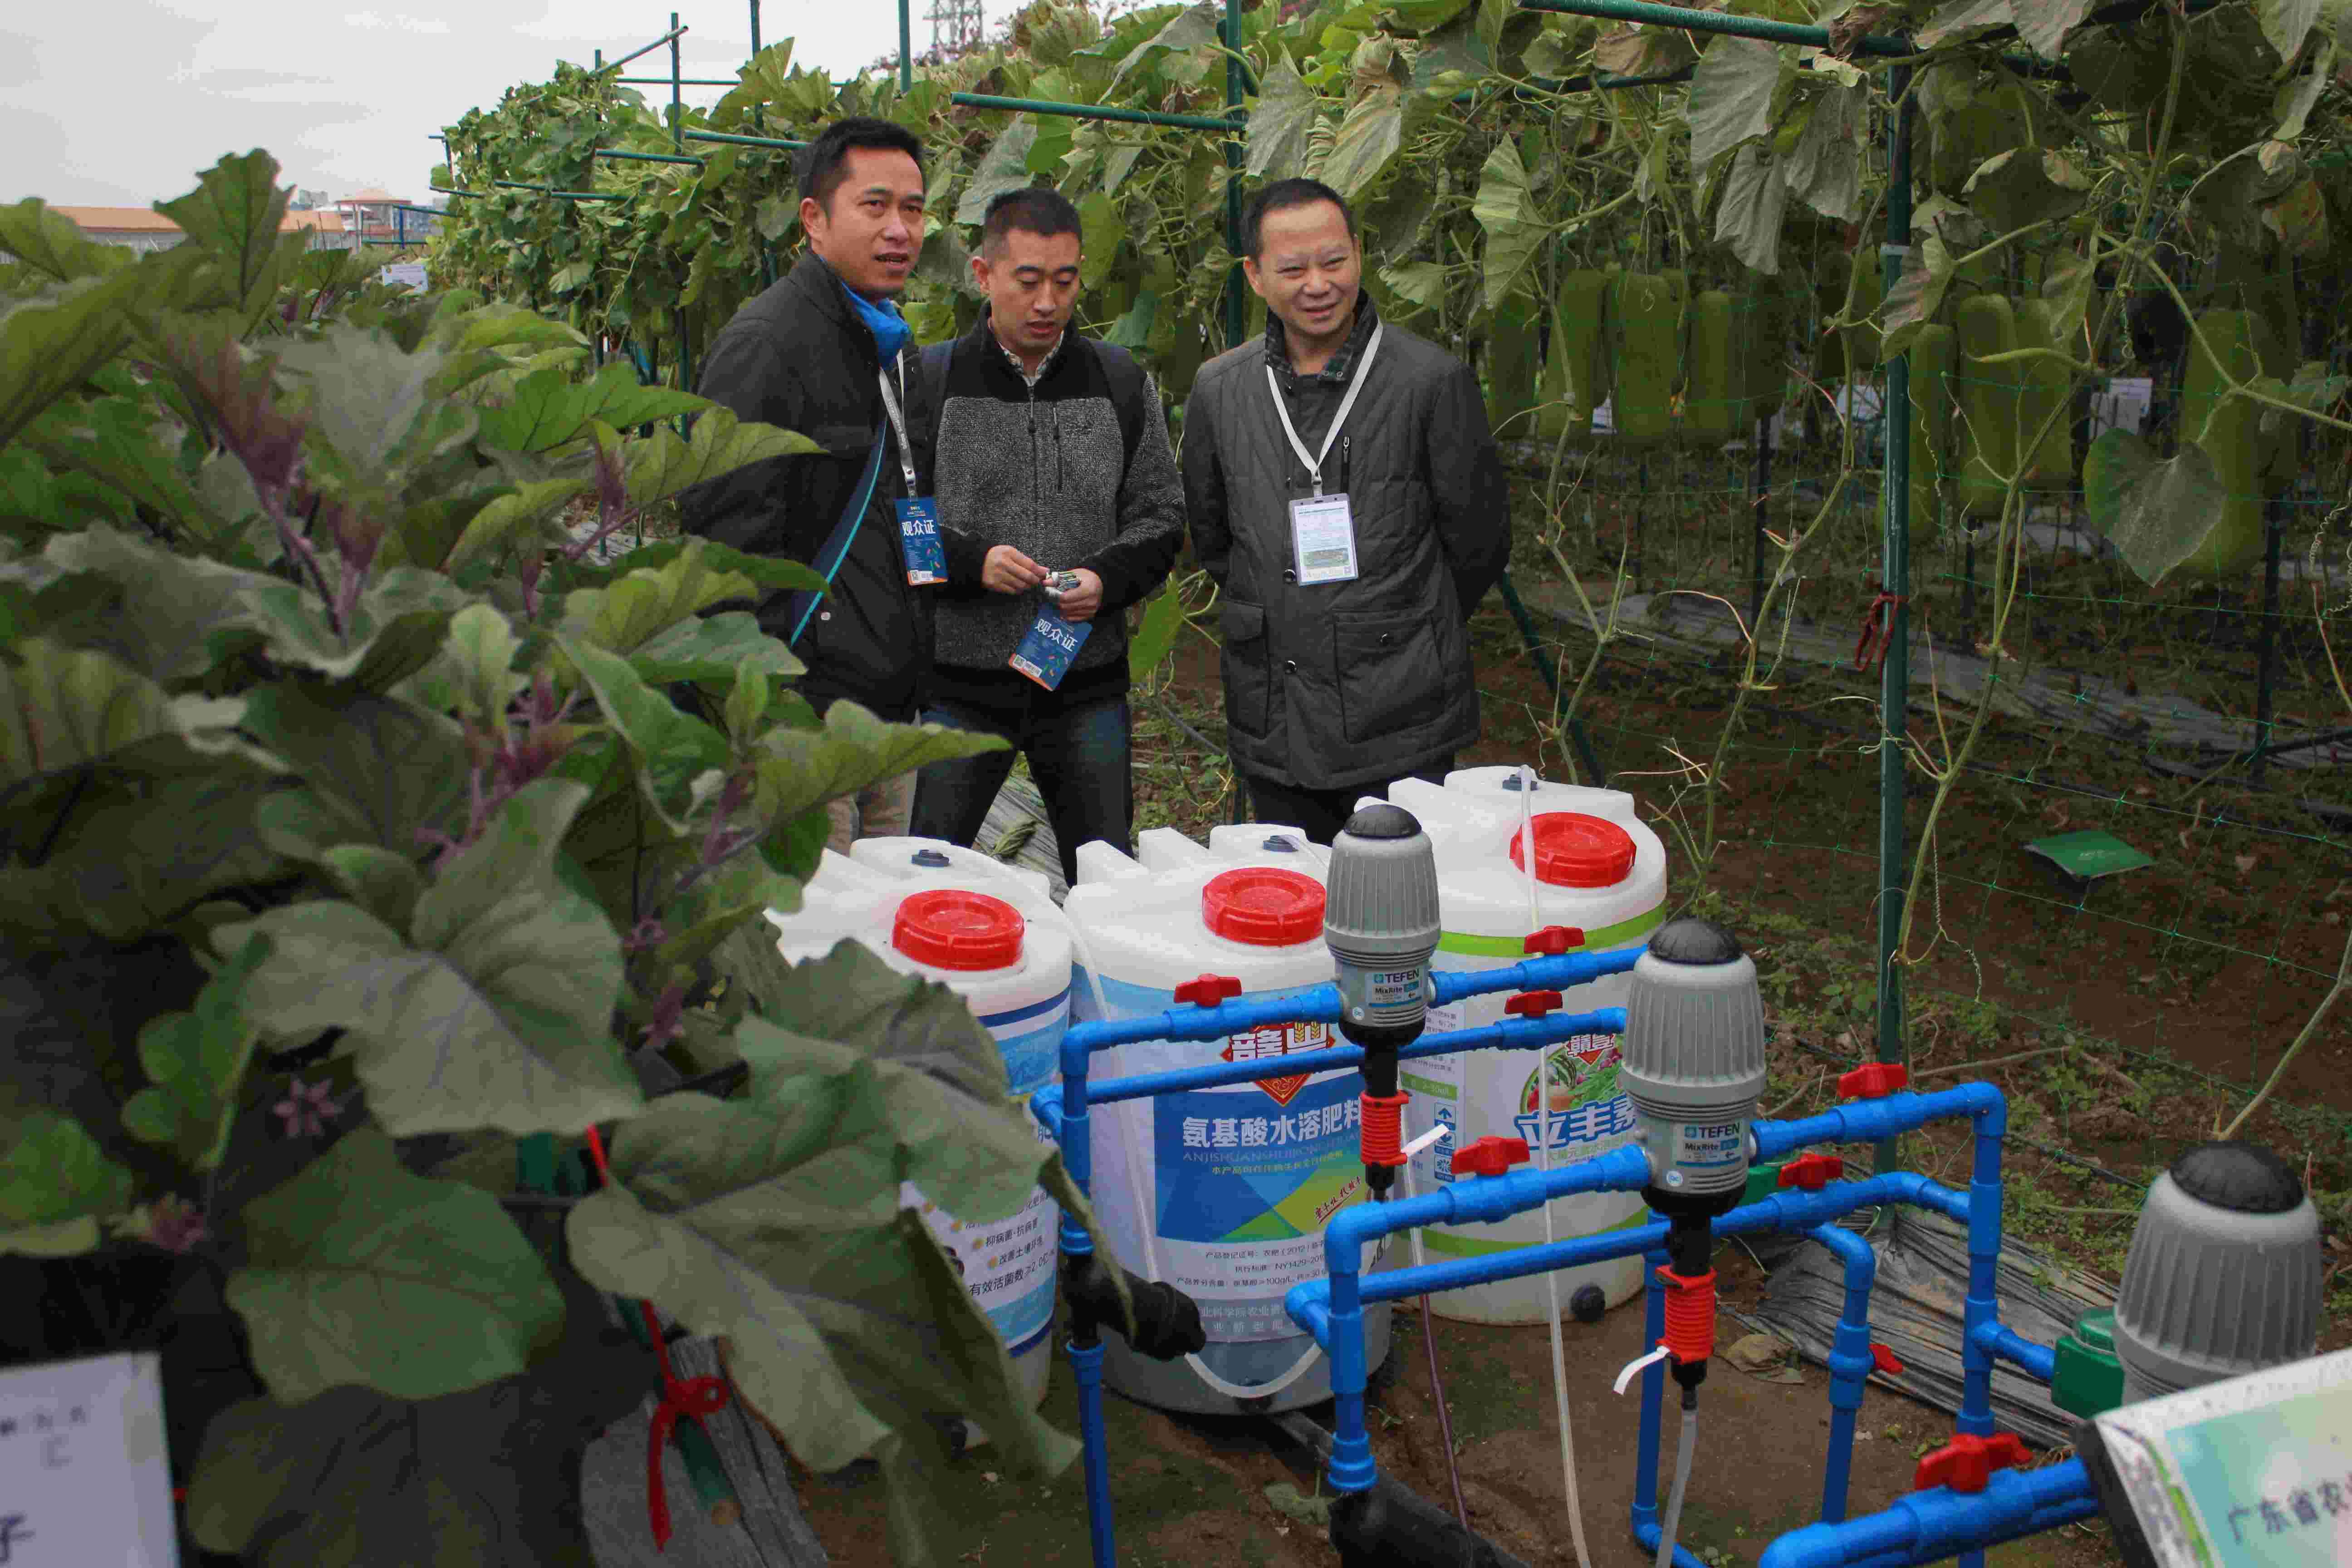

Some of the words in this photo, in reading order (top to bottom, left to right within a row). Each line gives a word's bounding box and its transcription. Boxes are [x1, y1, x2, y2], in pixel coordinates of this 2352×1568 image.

[902, 519, 936, 536] 观众证
[1034, 618, 1078, 652] 观众证
[1385, 968, 1420, 983] TEFEN
[1183, 1098, 1361, 1148] 氨基酸水溶肥料
[1698, 1122, 1740, 1138] TEFEN
[1685, 1142, 1719, 1151] MixRite
